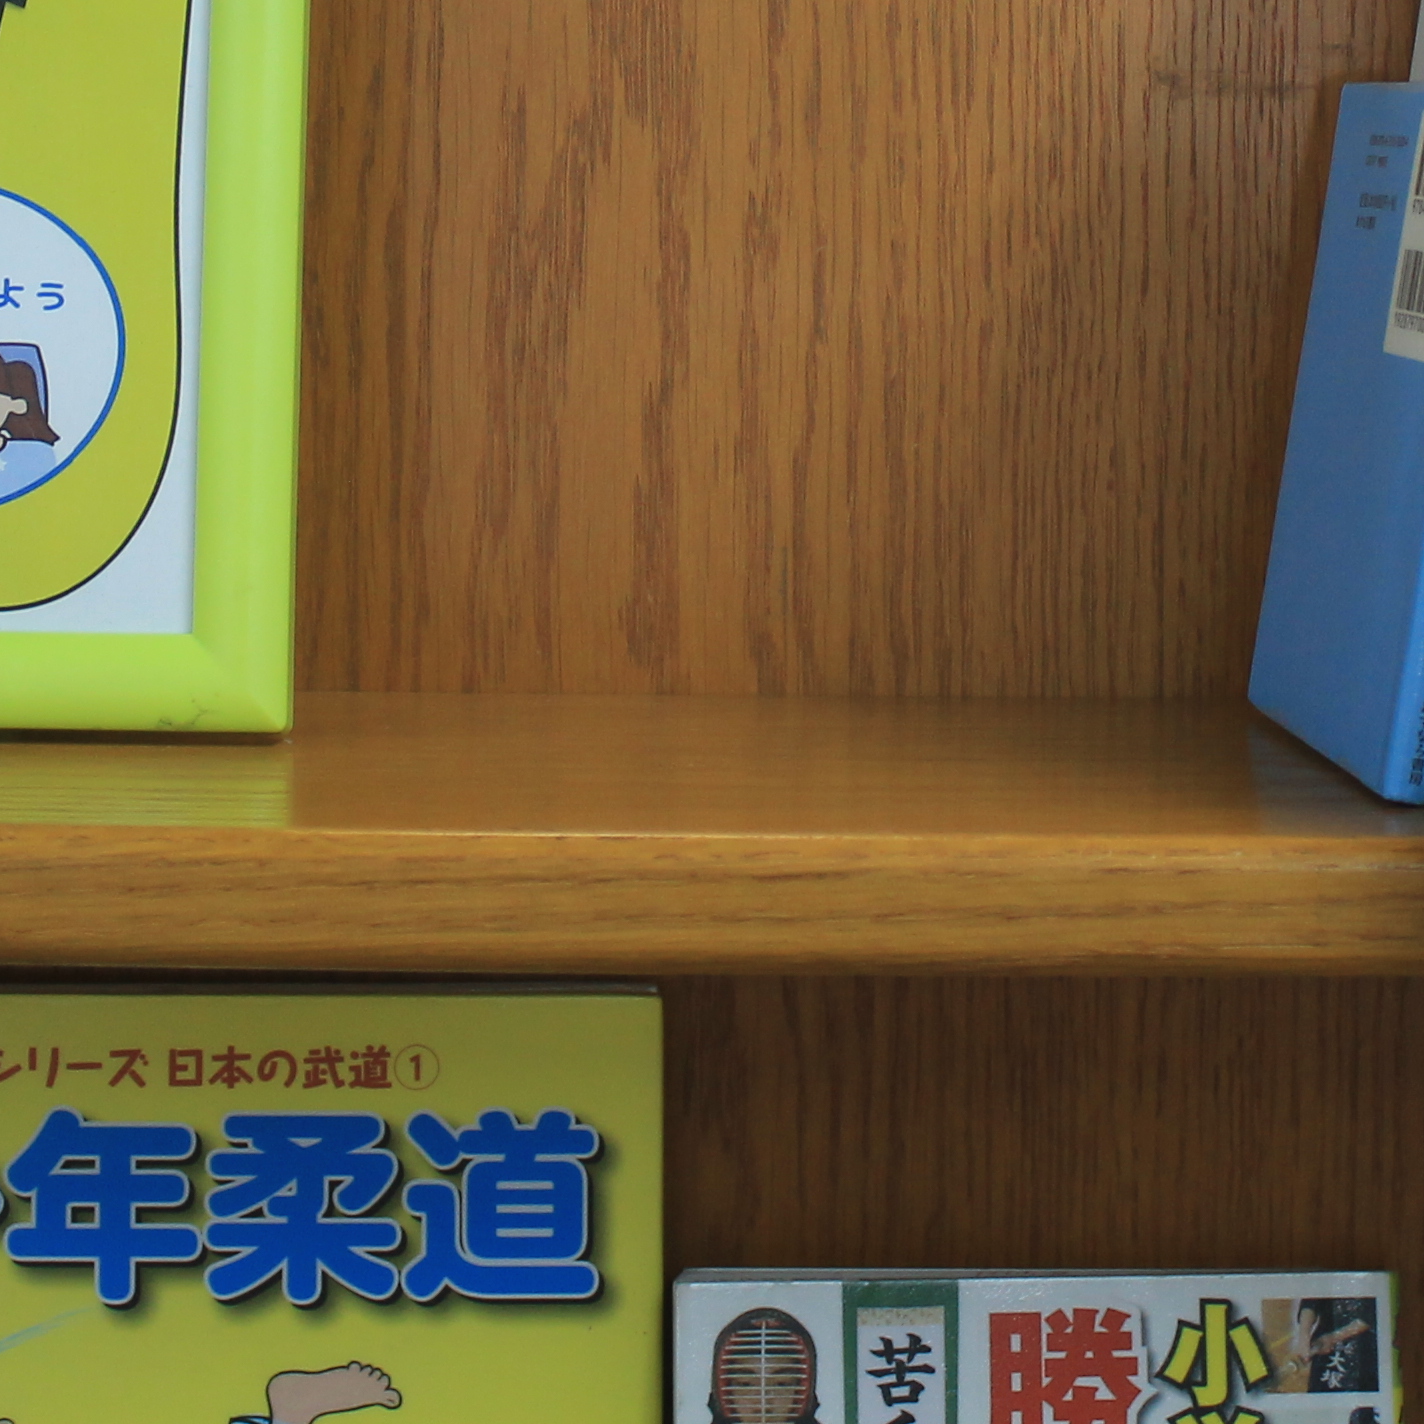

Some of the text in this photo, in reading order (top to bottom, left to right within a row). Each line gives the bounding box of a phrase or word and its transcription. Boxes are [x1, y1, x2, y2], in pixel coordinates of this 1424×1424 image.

[167, 1042, 441, 1091] 日本の武道①
